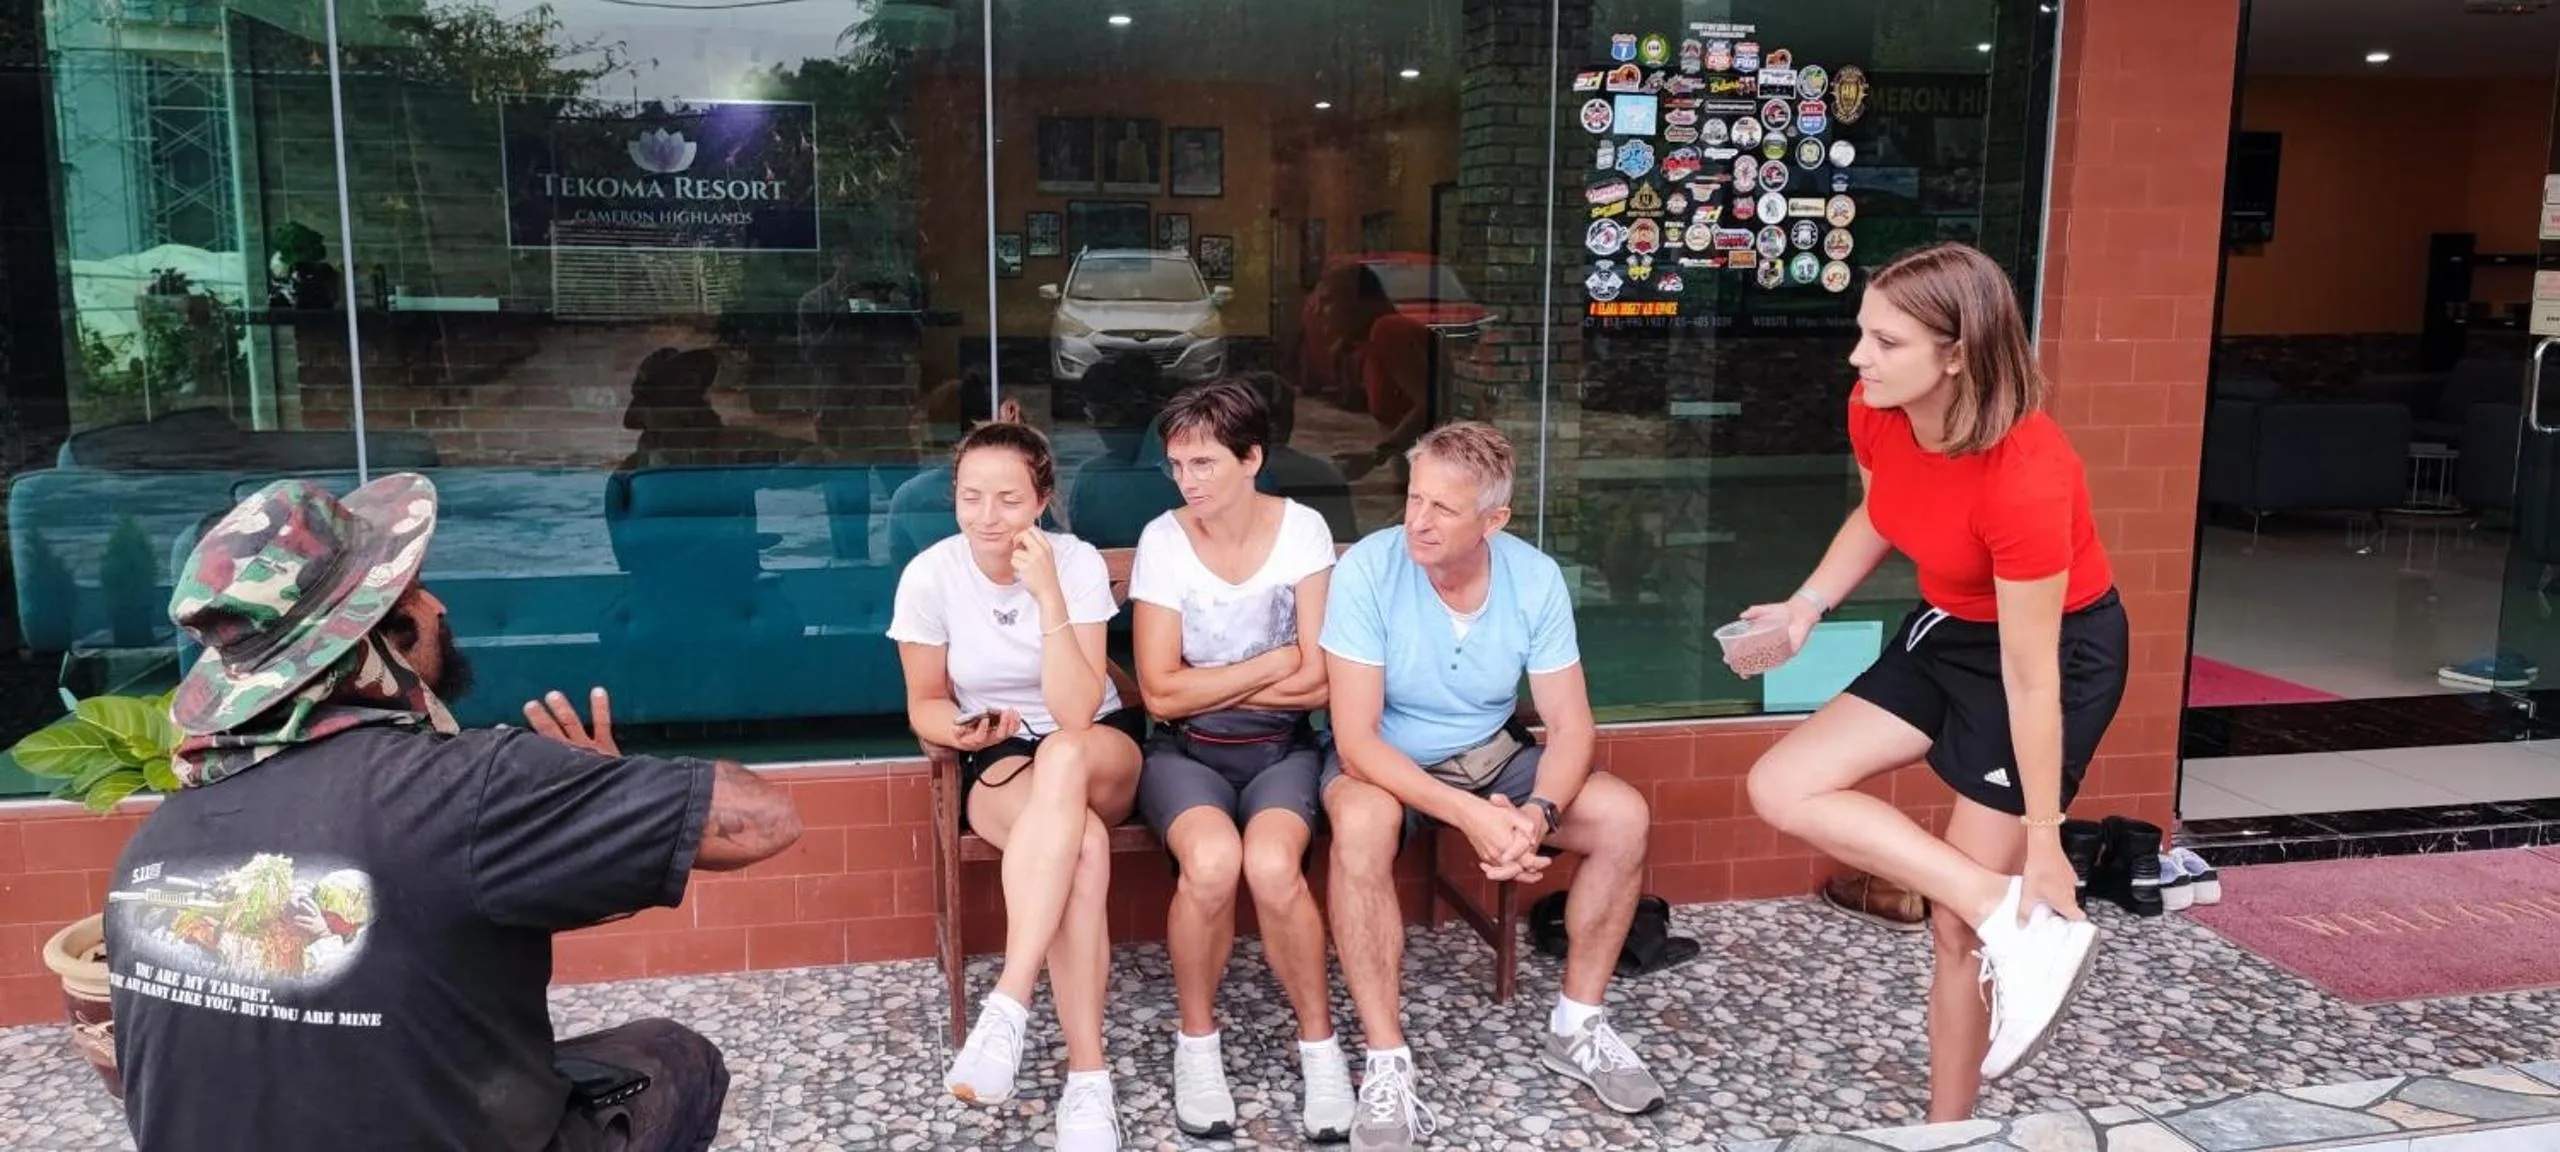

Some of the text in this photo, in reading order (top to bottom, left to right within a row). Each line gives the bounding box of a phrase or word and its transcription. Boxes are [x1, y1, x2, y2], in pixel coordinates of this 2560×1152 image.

[537, 172, 787, 201] TEKOMA RESORT
[574, 207, 754, 225] CAMERON HIGHLANDS
[156, 967, 180, 986] ARE
[183, 973, 206, 991] MY
[209, 979, 275, 1004] TARGET.
[171, 988, 202, 1006] LIKE
[204, 994, 238, 1014] YOU,
[240, 1001, 270, 1017] BUT
[271, 1005, 300, 1022] YOU
[303, 1011, 334, 1024] ARE
[339, 1013, 383, 1027] MINE
